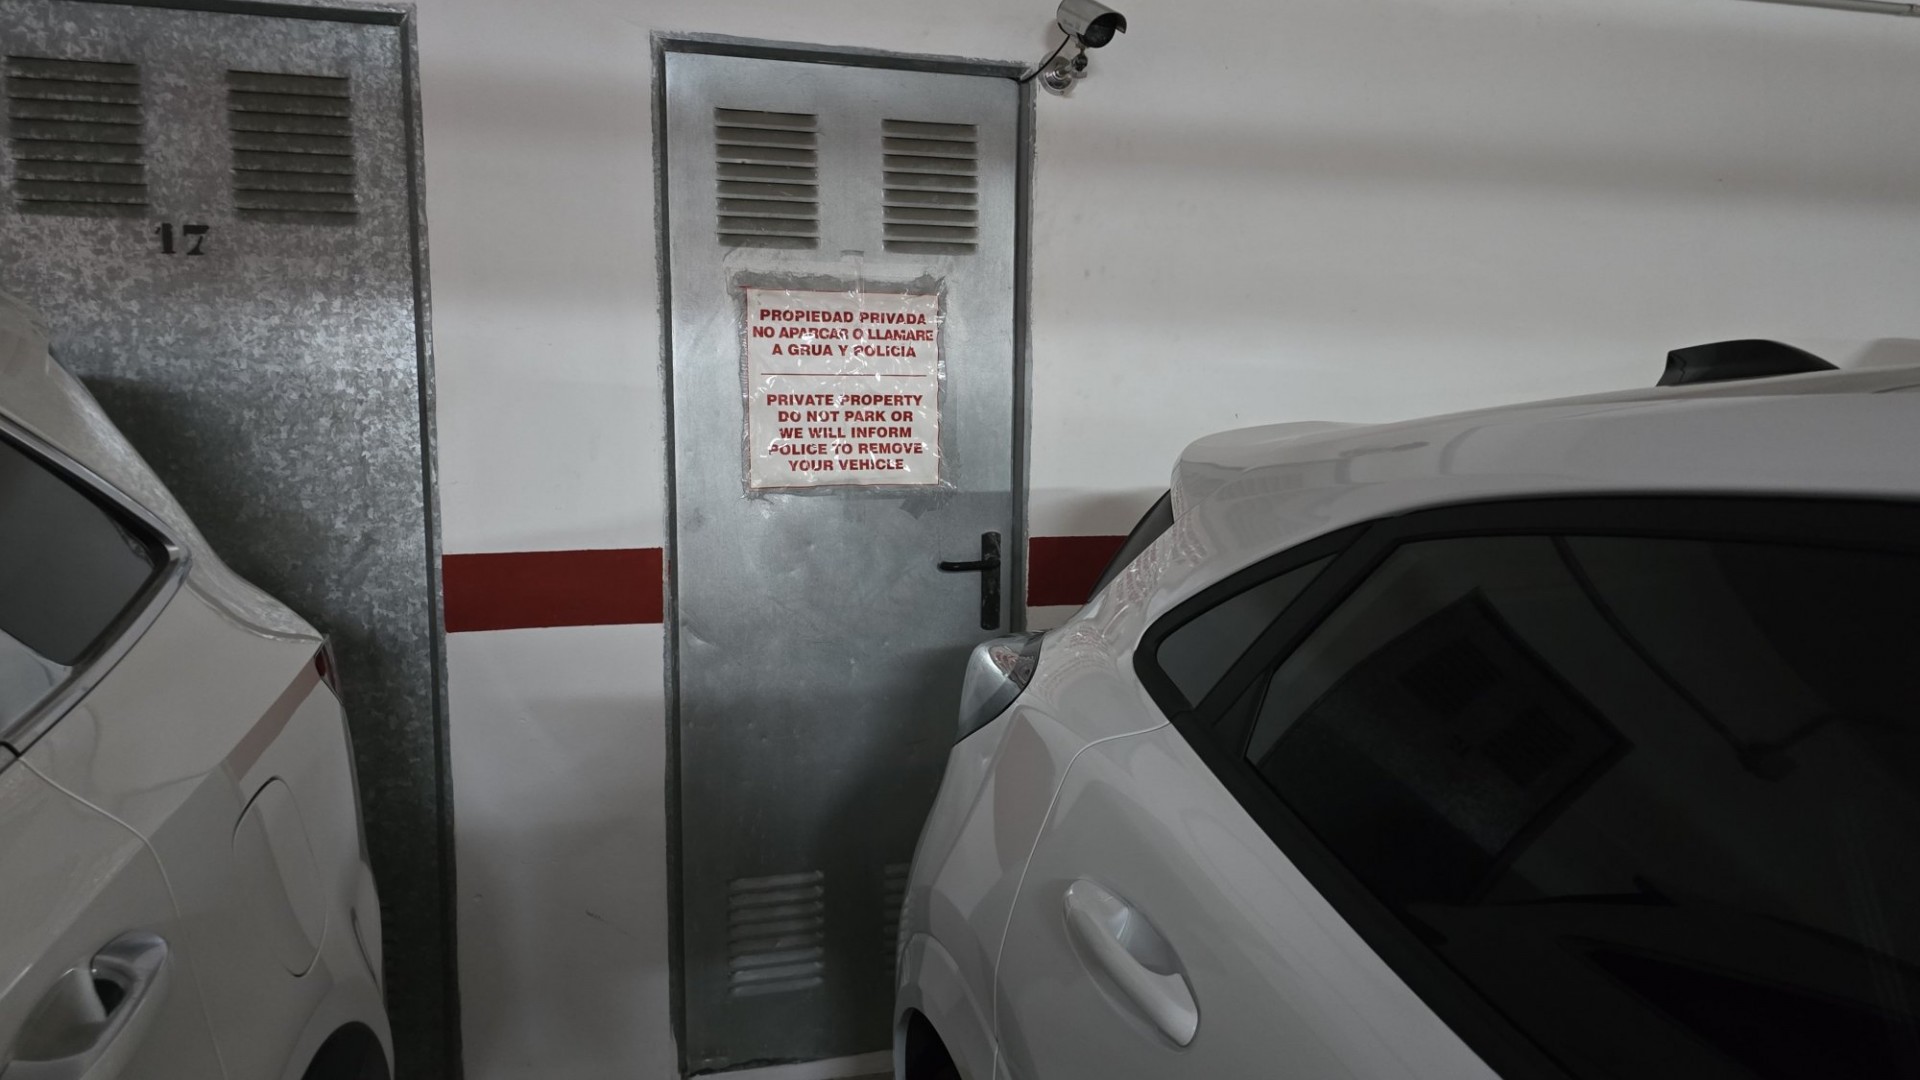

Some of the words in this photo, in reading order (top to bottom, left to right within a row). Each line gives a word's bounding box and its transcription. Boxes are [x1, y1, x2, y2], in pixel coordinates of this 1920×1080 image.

[154, 222, 210, 256] 17
[760, 309, 853, 322] PROPIEDAD
[860, 313, 926, 324] PRIVADA
[753, 327, 775, 338] NO
[853, 329, 863, 340] O
[868, 329, 933, 341] LLAMARE
[772, 344, 782, 355] A
[788, 345, 833, 356] GRUA
[838, 345, 848, 356] Y
[767, 394, 834, 406] PRIVATE
[840, 395, 923, 406] PROPERTY
[778, 411, 801, 422] DO
[807, 411, 839, 422] NOT
[845, 411, 886, 421] PARK
[891, 411, 913, 421] OR
[780, 428, 803, 438] WE
[809, 428, 845, 438] WILL
[852, 428, 911, 438] INFORM
[769, 444, 827, 455] POLICE
[833, 444, 852, 454] TO
[858, 443, 922, 454] REMOVE
[789, 460, 833, 471] YOUR
[839, 459, 904, 470] VEHICLE
